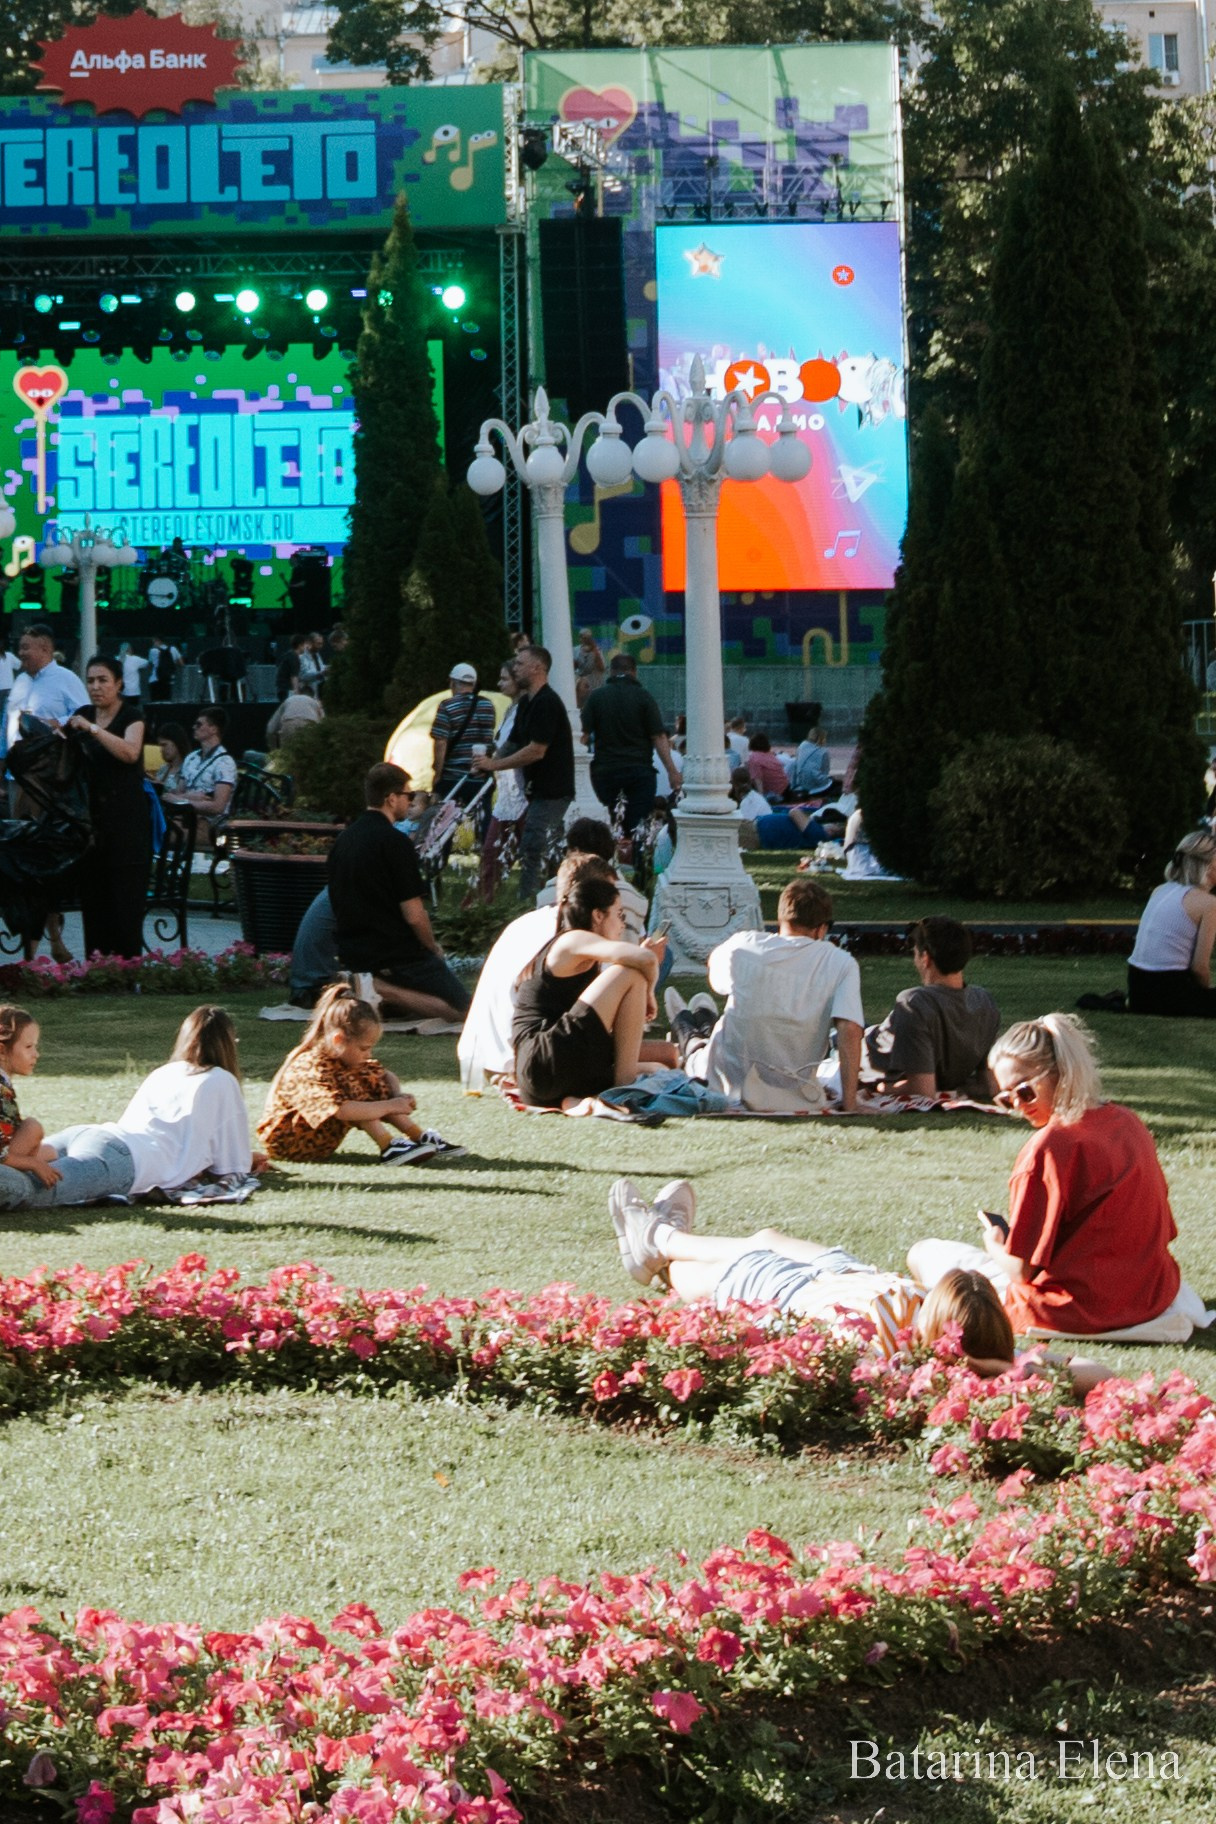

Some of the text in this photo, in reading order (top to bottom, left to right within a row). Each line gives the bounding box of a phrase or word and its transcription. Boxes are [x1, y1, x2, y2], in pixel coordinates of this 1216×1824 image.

[70, 49, 207, 77] Альфа Банк
[57, 411, 356, 511] STEREOLETO
